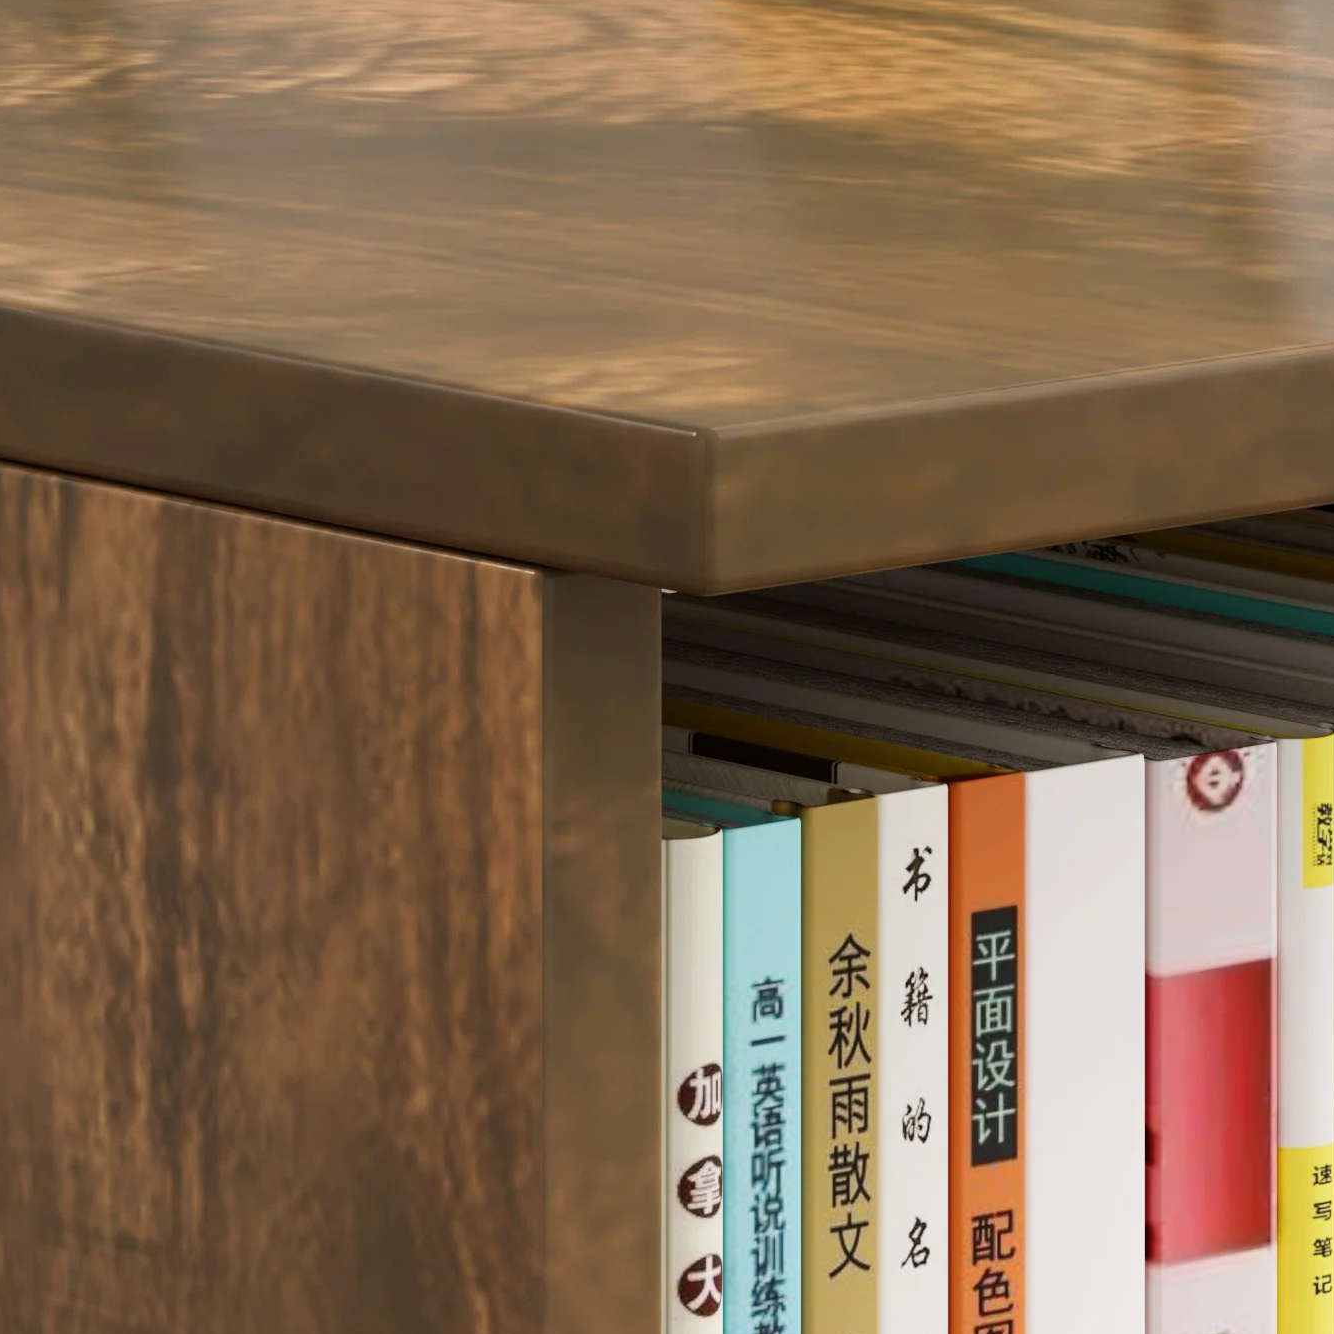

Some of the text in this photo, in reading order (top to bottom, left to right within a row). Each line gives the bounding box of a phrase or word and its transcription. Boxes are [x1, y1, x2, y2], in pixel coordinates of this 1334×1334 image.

[828, 933, 872, 1279] 余秋雨散文
[972, 929, 1016, 1145] 平面设计
[1312, 1164, 1333, 1295] 速写笔记
